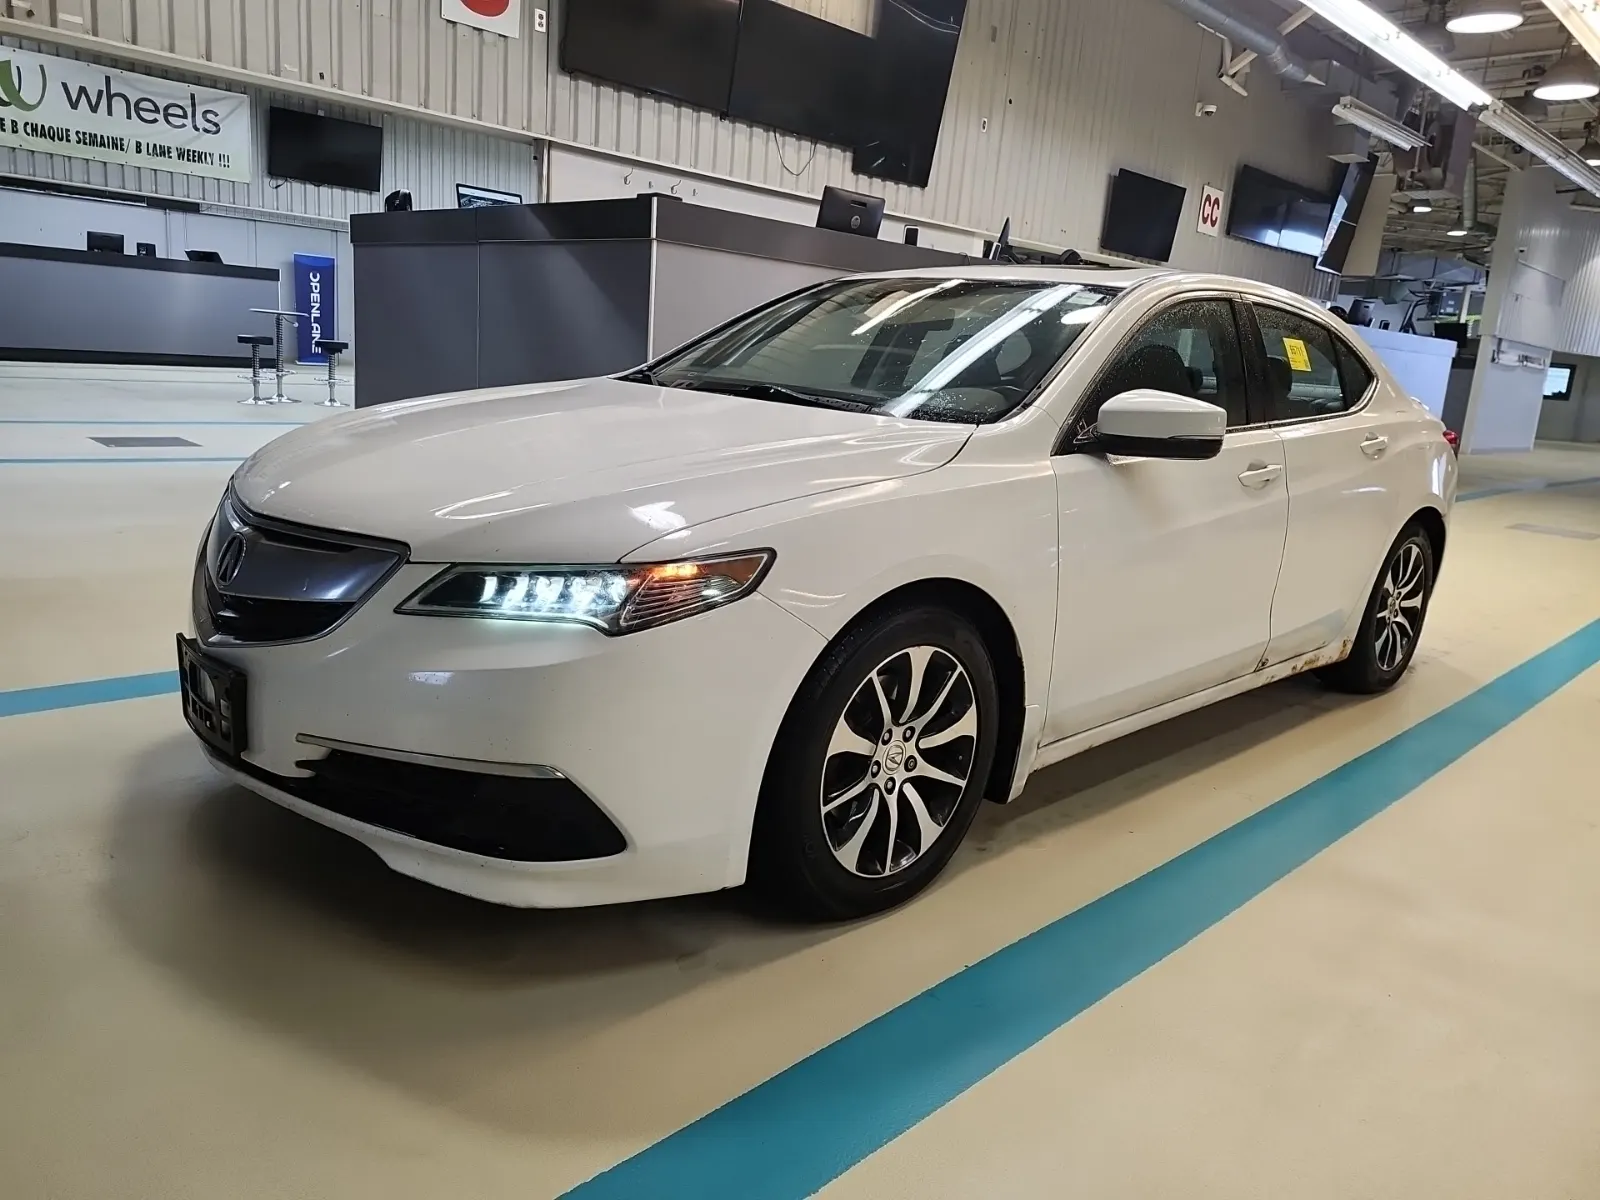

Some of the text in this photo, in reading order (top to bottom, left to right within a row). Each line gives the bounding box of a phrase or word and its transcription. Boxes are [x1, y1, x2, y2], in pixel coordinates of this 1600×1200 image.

[61, 75, 221, 135] wheels
[10, 119, 19, 134] B
[23, 121, 71, 142] CHAQUE
[75, 130, 130, 153] SEMAINE/
[135, 140, 142, 154] B
[146, 142, 173, 159] LANE
[176, 147, 214, 166] WEEKLY
[1202, 194, 1220, 228] CC
